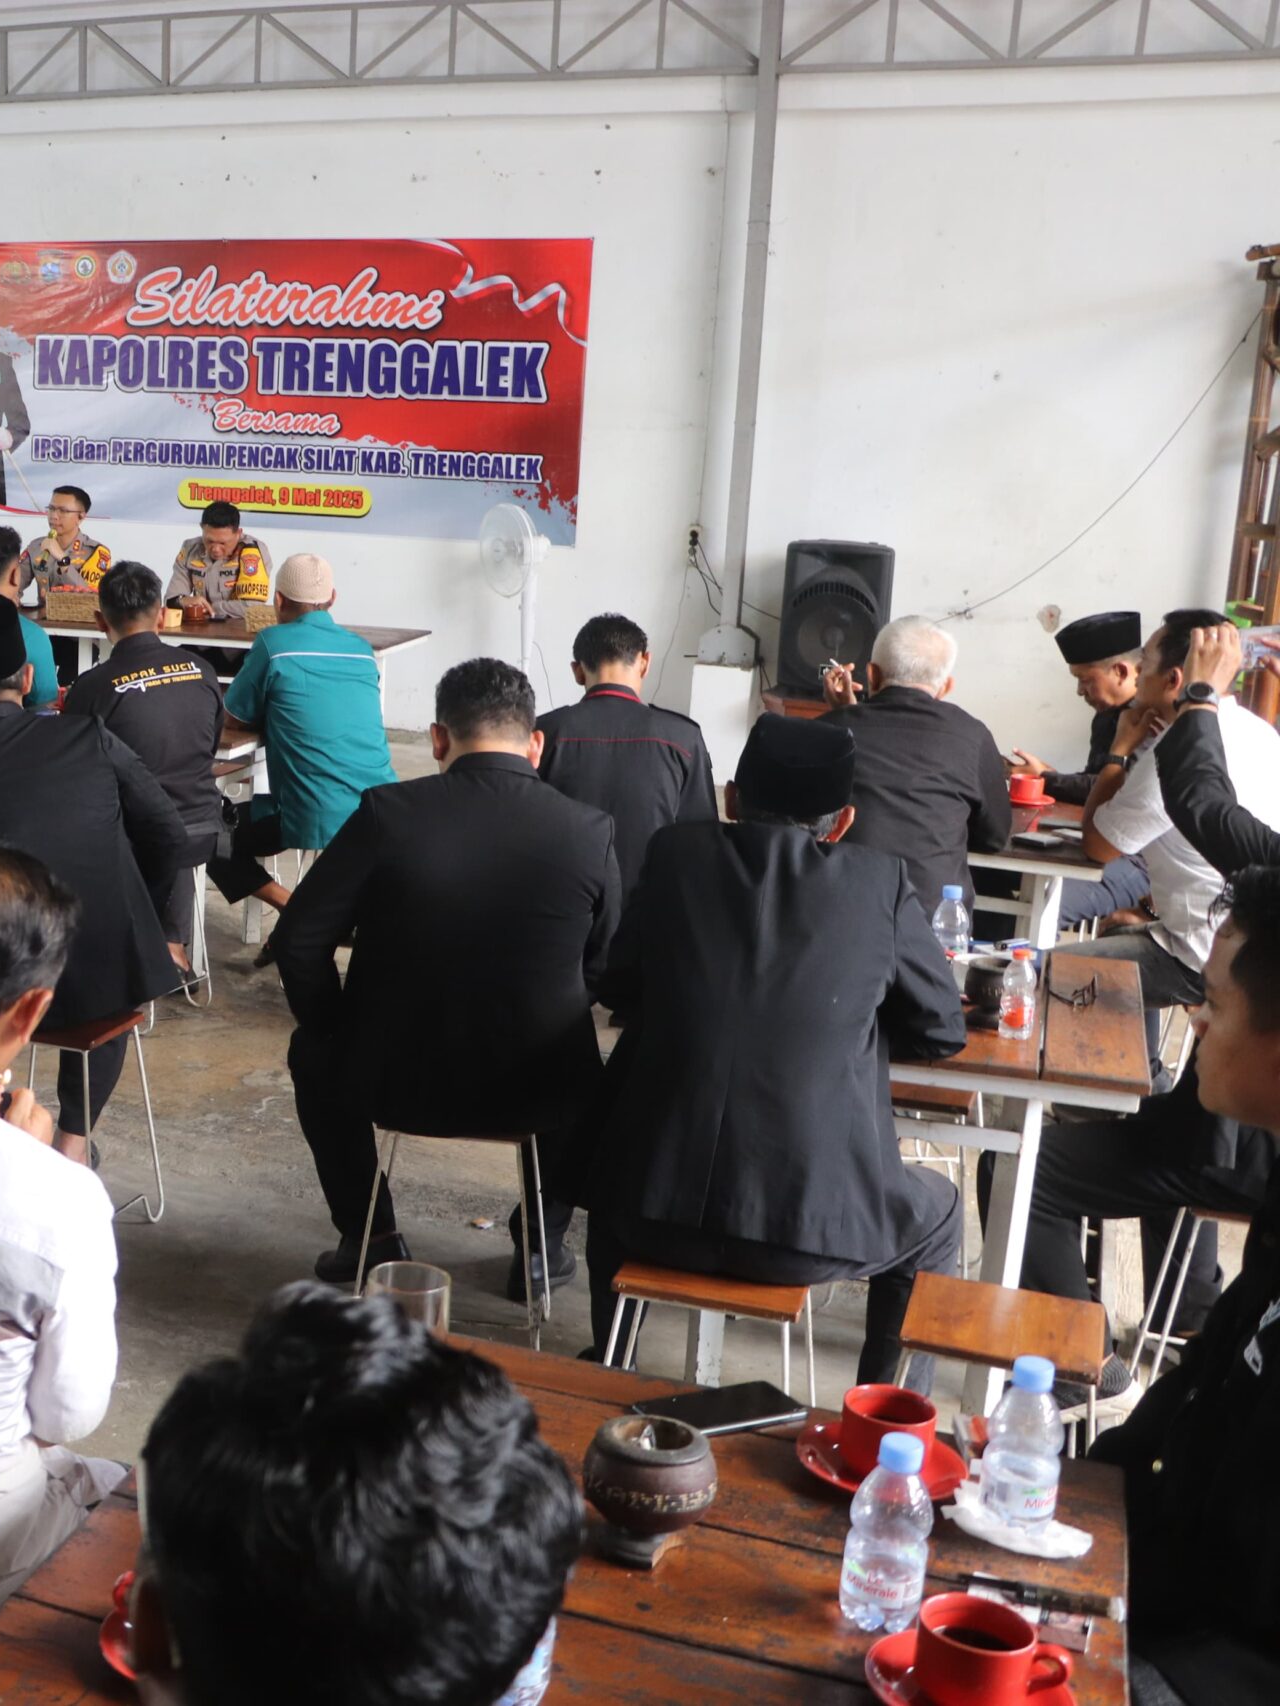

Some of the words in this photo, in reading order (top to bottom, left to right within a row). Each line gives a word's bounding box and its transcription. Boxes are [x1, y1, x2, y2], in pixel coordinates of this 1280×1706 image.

[128, 266, 444, 329] Silaturahmi
[36, 337, 246, 391] KAPOLRES
[255, 340, 544, 399] TRENGGALEK
[216, 401, 339, 434] Bersama
[33, 437, 70, 461] IPSI
[72, 438, 107, 462] dan
[111, 440, 220, 467] PERGURUAN
[224, 445, 300, 470] PENCAK
[302, 447, 357, 472] SILAT
[360, 450, 408, 475] KAB.
[410, 452, 541, 481] TRENGGALEK
[188, 482, 277, 506] Trenggalek,
[278, 487, 290, 505] 9
[292, 488, 321, 507] Mei
[322, 489, 364, 510] 2025
[80, 569, 101, 583] KAOP
[112, 667, 157, 686] TAPAK
[162, 661, 192, 674] SUCI
